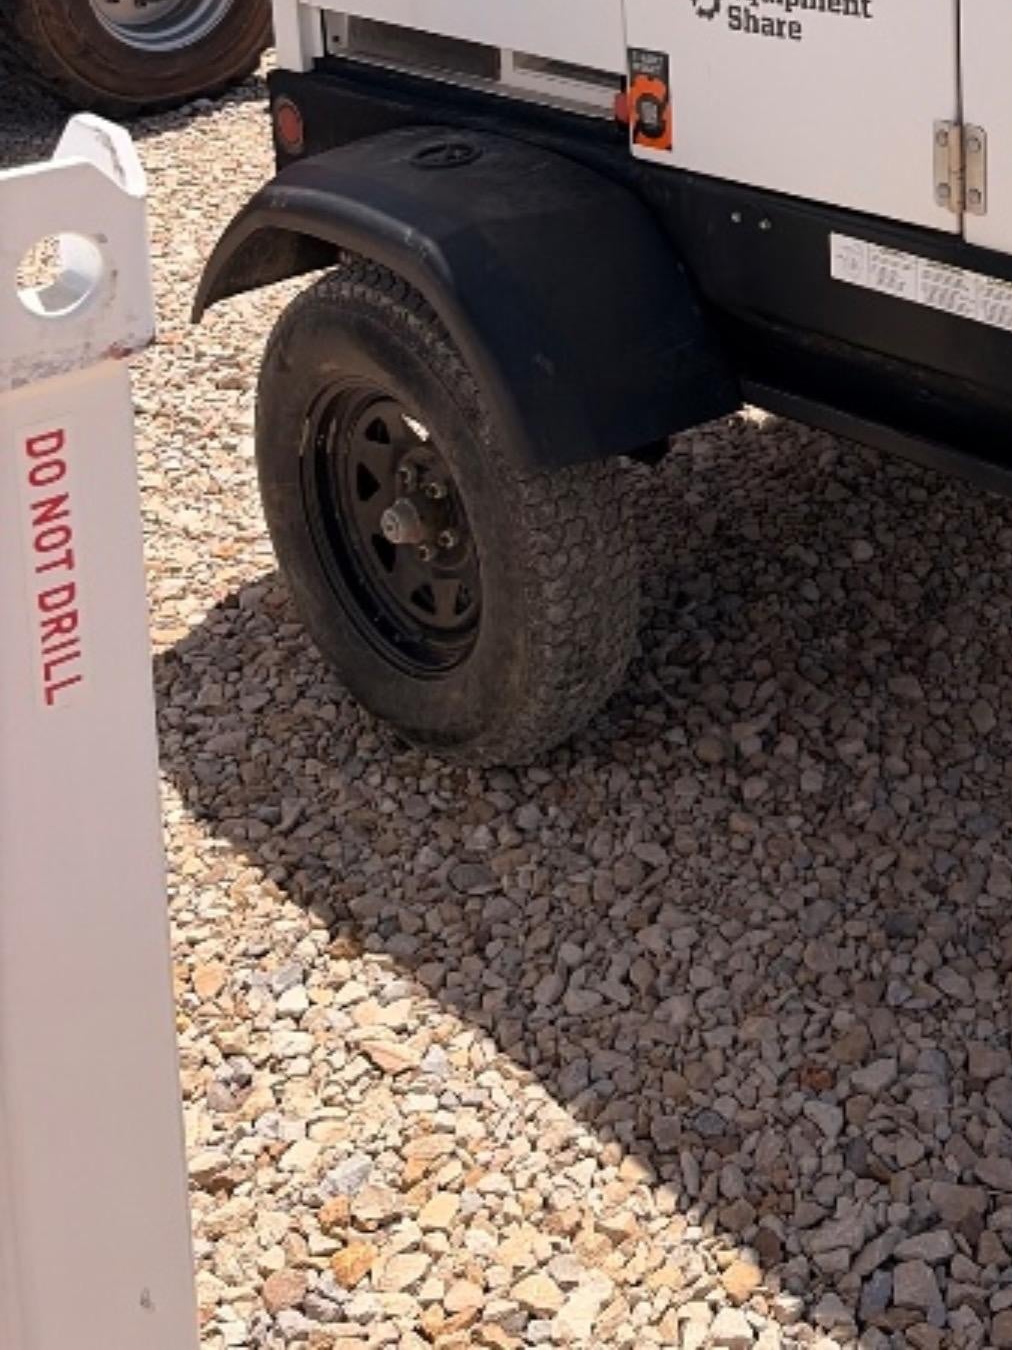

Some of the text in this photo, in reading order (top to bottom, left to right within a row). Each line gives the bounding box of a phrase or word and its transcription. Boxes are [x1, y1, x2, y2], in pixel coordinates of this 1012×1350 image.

[728, 5, 802, 40] Share
[26, 429, 82, 705] DO NOT DRILL
